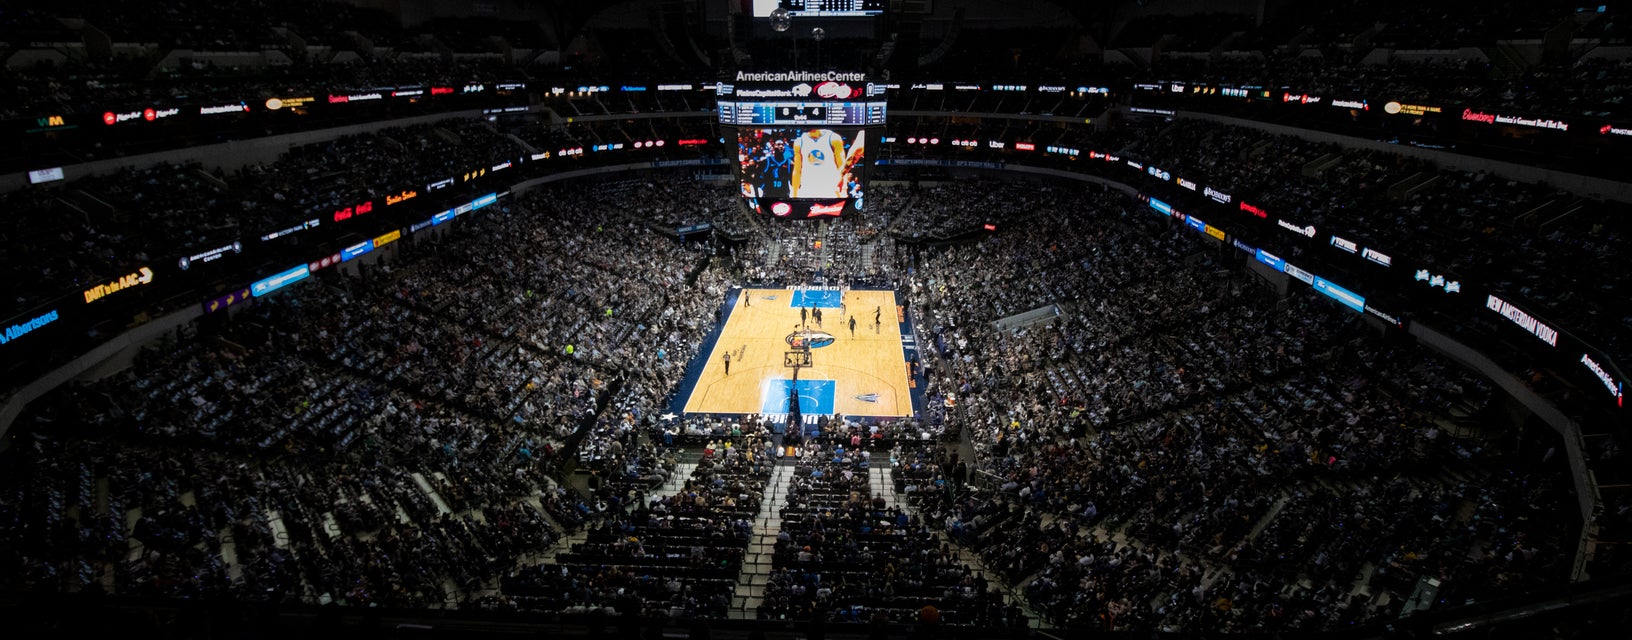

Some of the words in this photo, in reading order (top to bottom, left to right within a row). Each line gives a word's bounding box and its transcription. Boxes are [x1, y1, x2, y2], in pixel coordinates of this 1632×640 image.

[1172, 84, 1184, 93] Uber
[990, 140, 1004, 149] Uber
[6, 309, 59, 341] Albertsons
[1487, 294, 1503, 312] NEW
[1500, 301, 1537, 334] AMSTERDAM
[1535, 321, 1558, 347] VODKA
